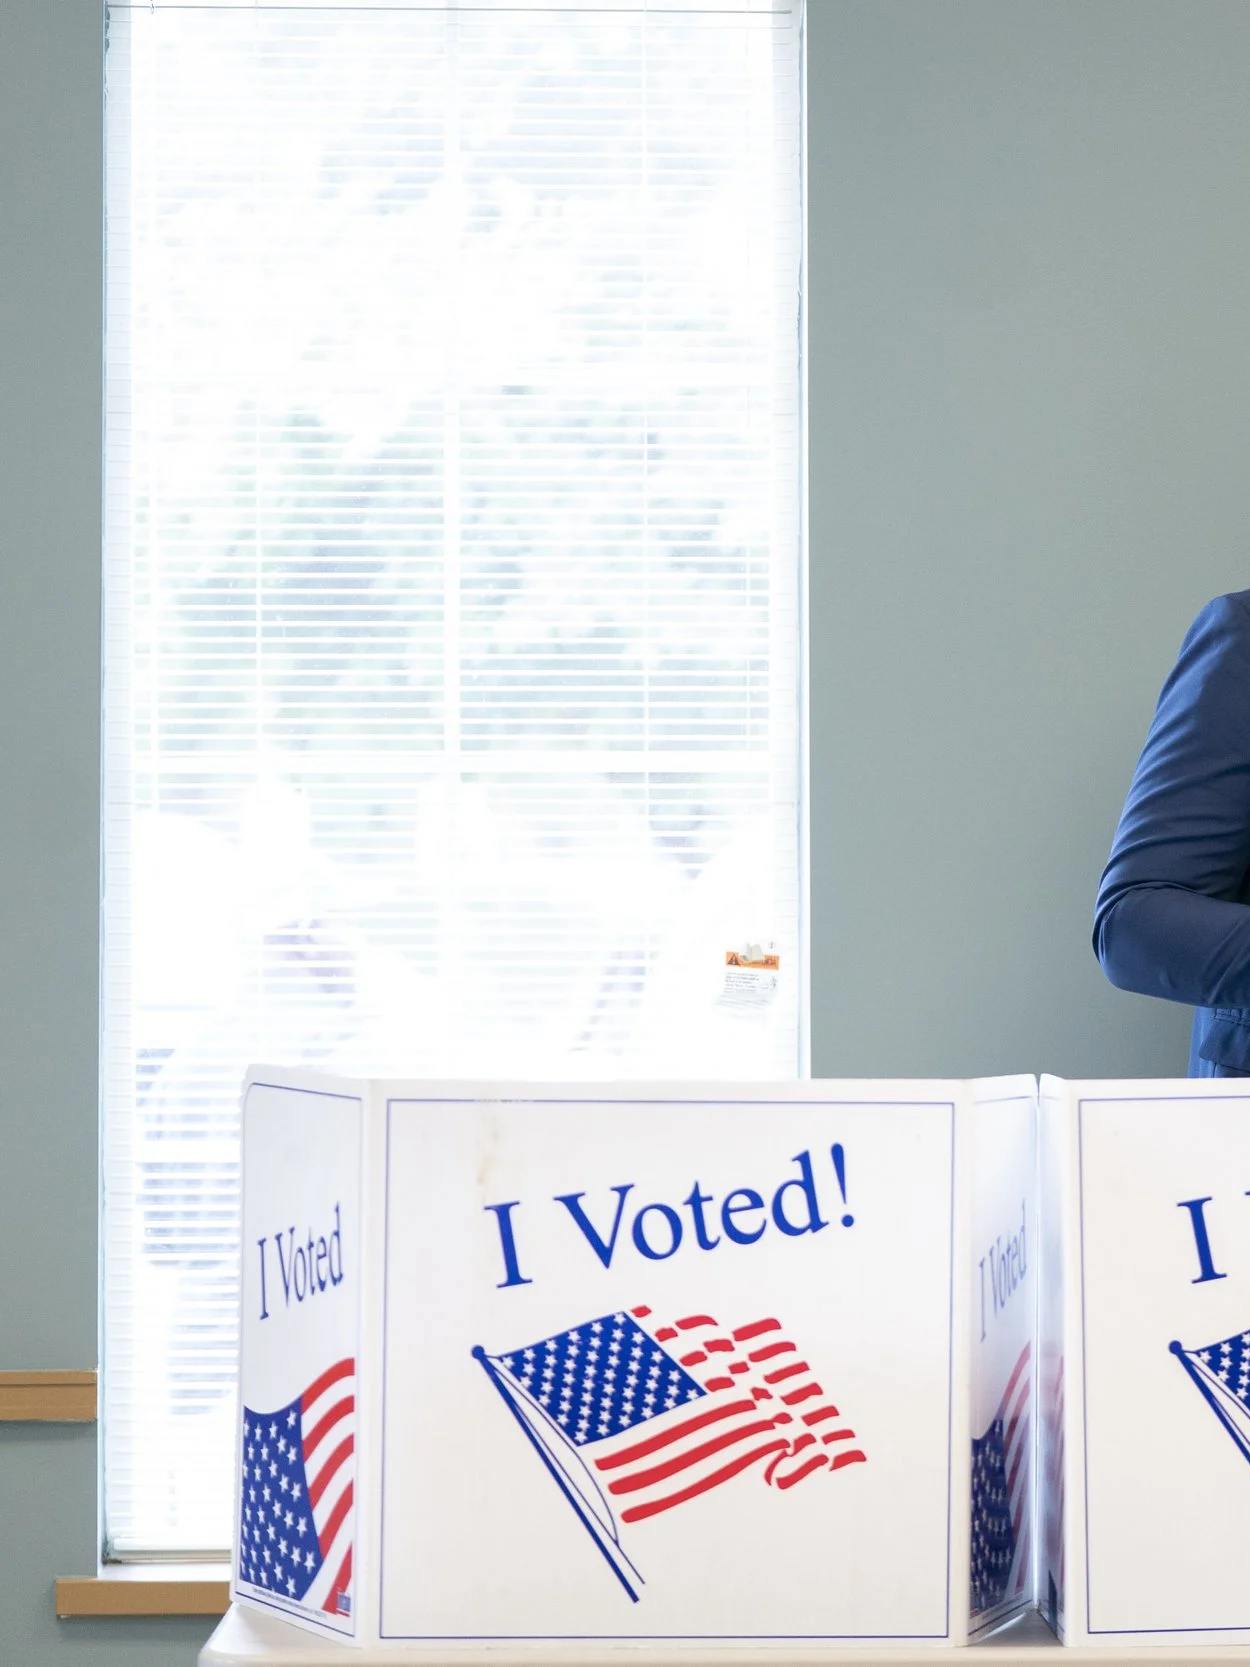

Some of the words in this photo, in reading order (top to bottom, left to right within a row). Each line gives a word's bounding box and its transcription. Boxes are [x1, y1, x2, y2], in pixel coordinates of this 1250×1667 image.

[257, 1237, 269, 1321] I
[274, 1200, 344, 1309] Voted
[484, 1200, 532, 1288] I
[554, 1142, 855, 1269] Voted!
[979, 1256, 986, 1343] I
[989, 1198, 1027, 1318] Voted
[1178, 1197, 1226, 1283] I
